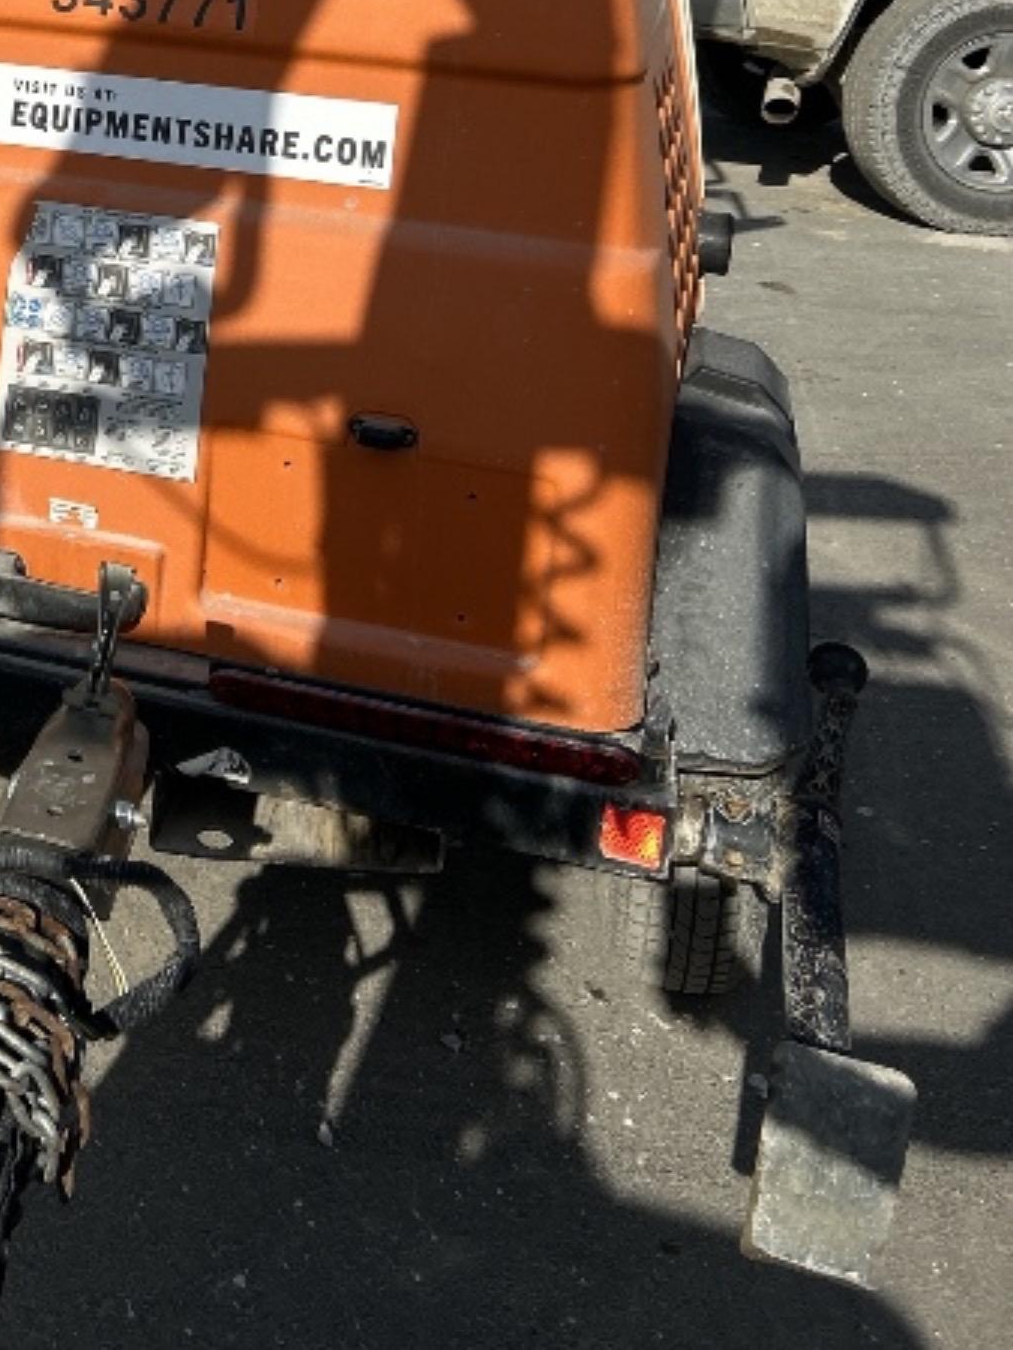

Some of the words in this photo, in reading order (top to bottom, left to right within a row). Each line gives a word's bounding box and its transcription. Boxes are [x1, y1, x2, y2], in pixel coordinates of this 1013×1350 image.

[13, 77, 58, 97] VISIT
[64, 83, 87, 100] US
[11, 99, 387, 171] EQUIPMENTSHARE.COM
